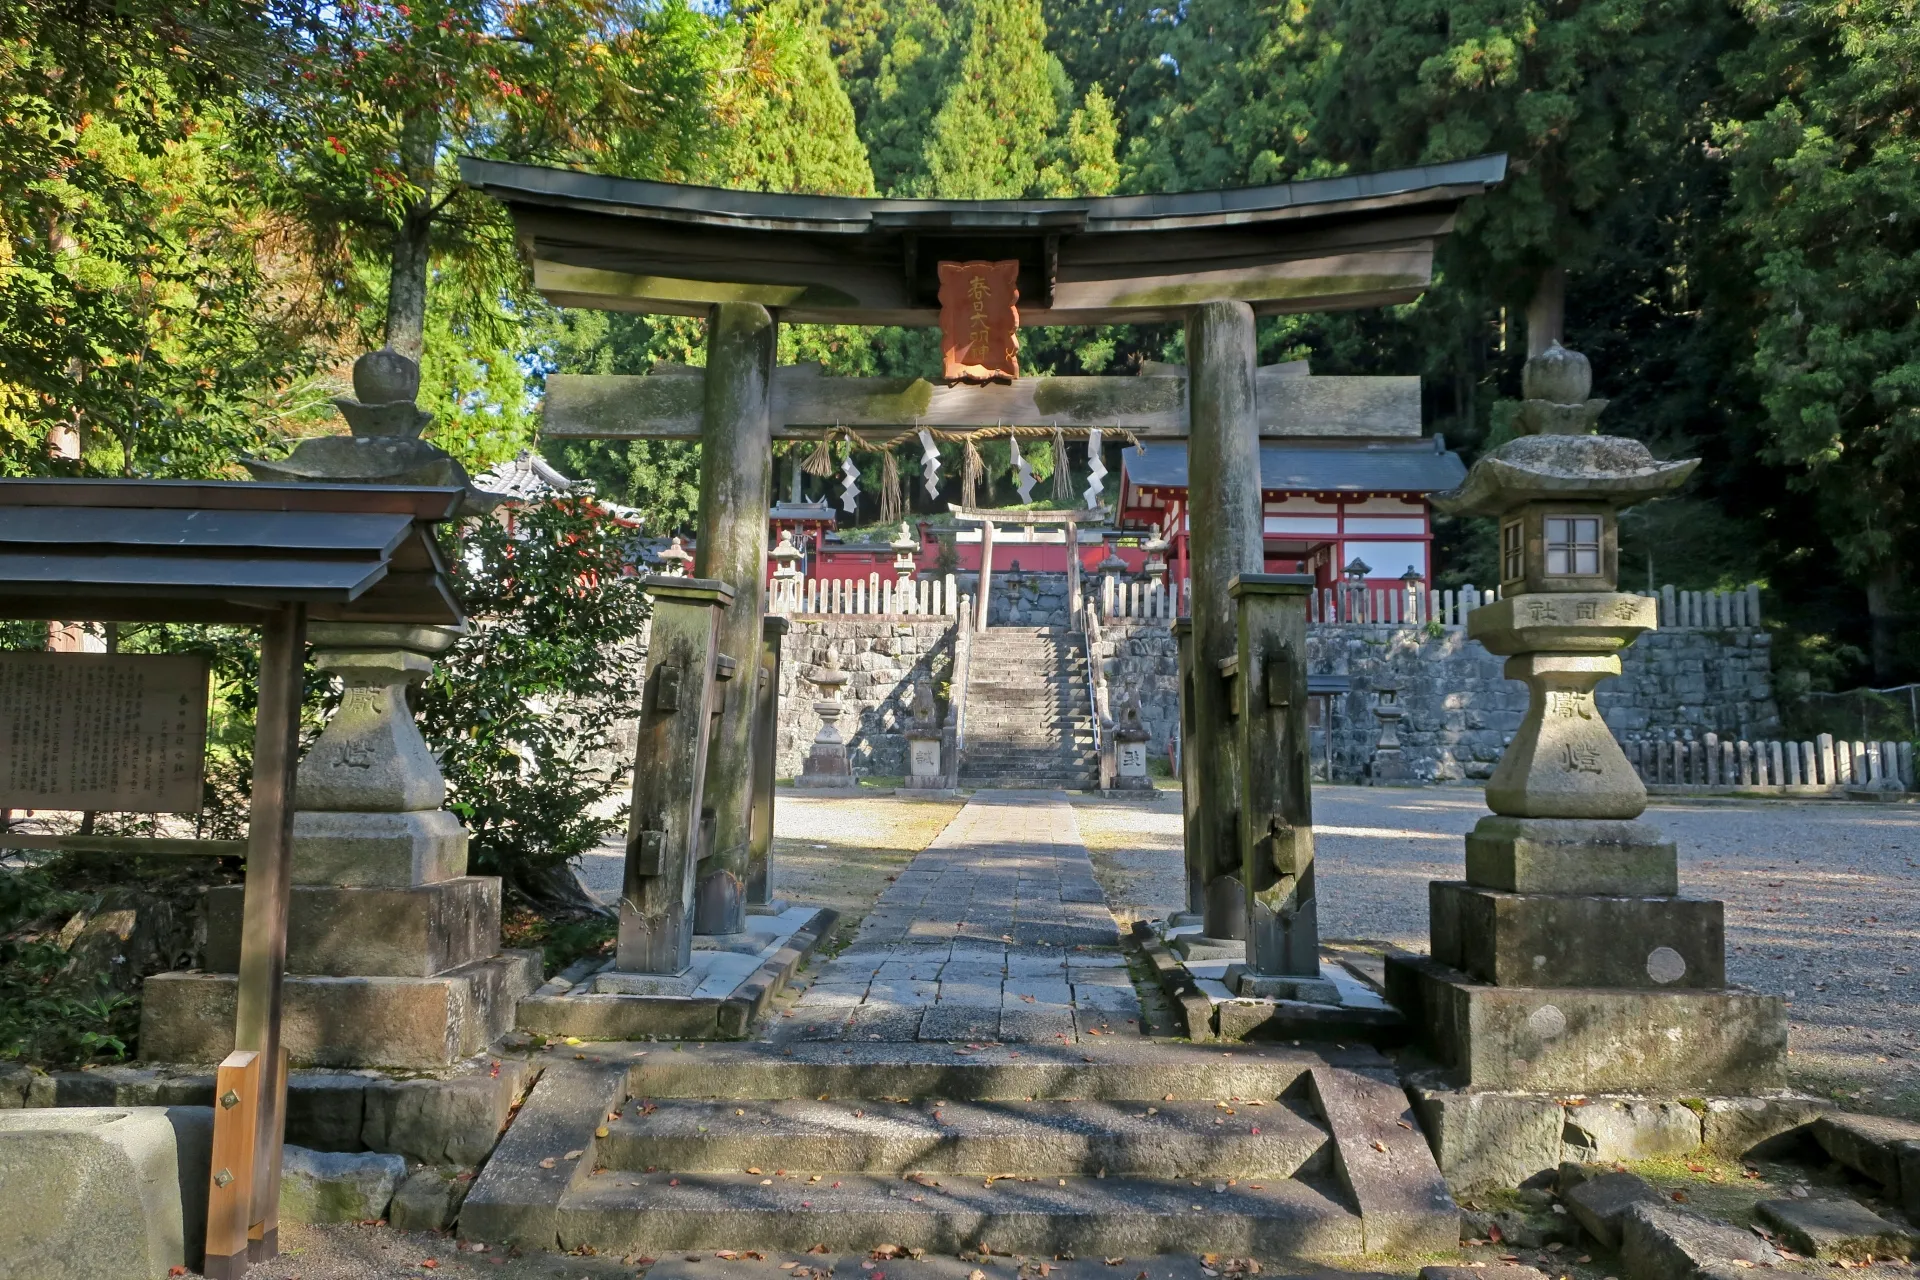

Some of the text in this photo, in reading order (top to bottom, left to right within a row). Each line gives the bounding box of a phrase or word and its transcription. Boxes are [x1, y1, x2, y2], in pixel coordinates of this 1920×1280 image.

[967, 275, 992, 361] 春日大明神
